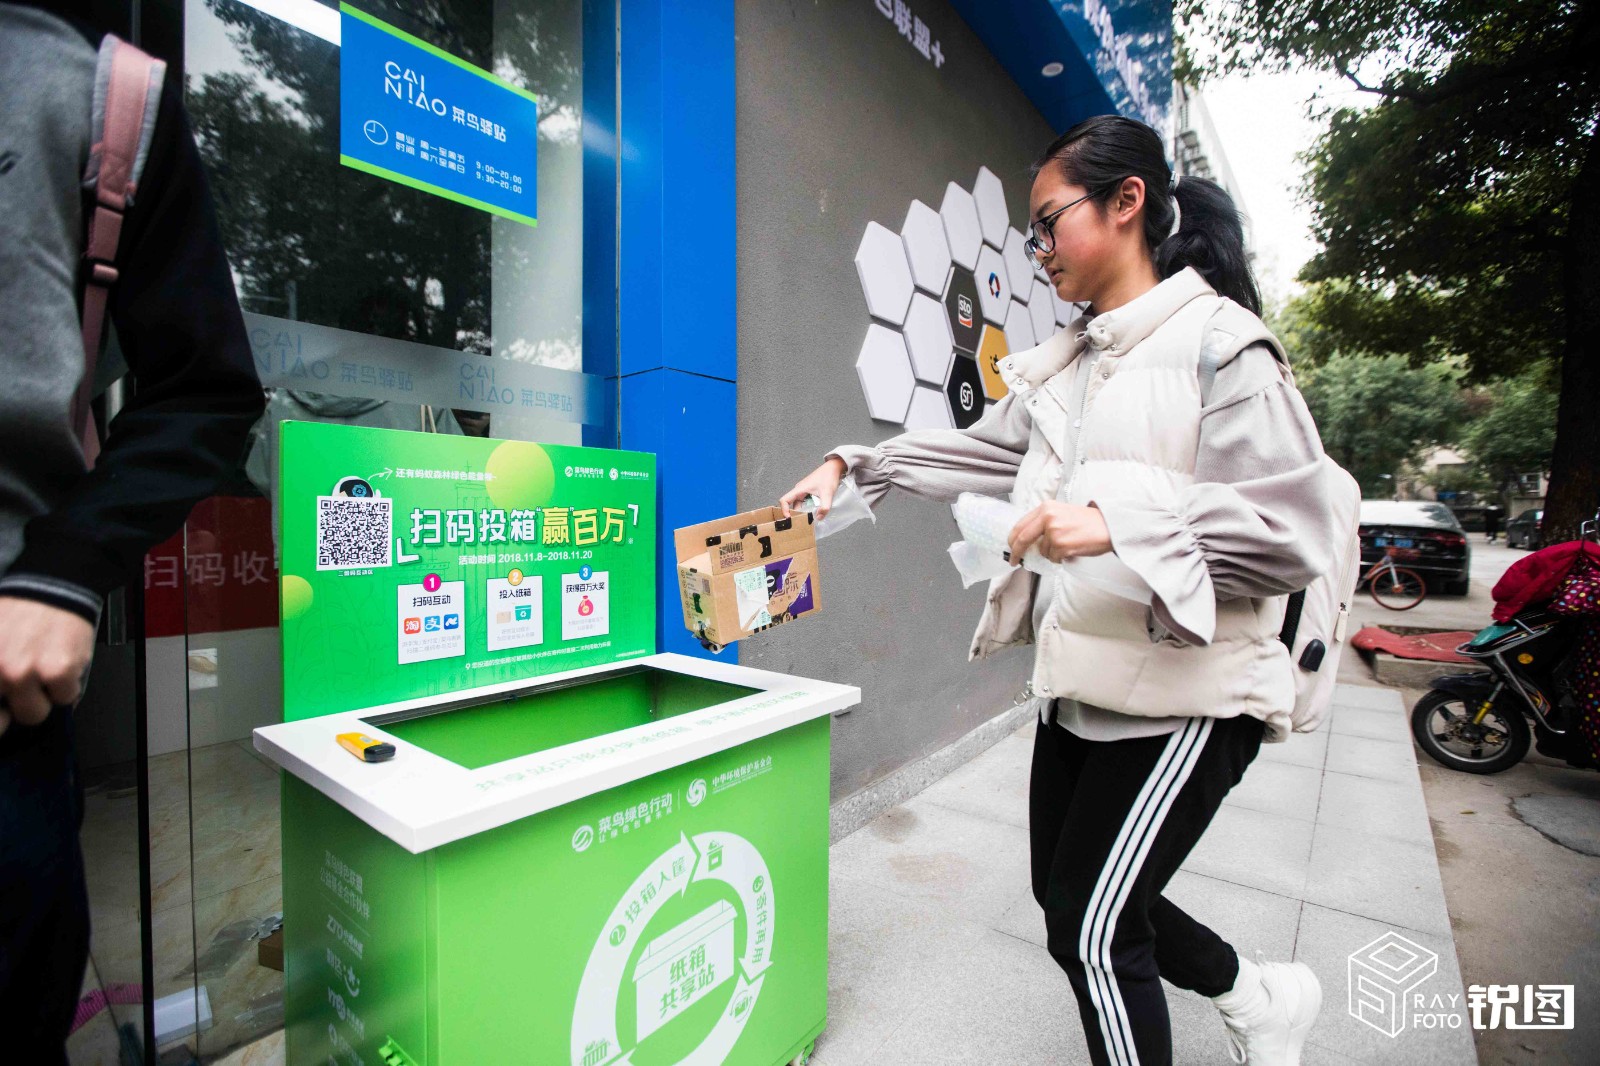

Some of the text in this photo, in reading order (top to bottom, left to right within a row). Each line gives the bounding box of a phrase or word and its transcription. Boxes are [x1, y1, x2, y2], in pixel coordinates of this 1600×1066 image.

[385, 61, 425, 92] CAI
[385, 77, 507, 143] NIAO 菜鸟驿站
[420, 140, 465, 164] 周一至周五
[476, 160, 522, 185] 9:00-20:00
[420, 150, 465, 174] 周六至周日
[476, 170, 522, 195] 9:30-20:00
[341, 361, 414, 392] 菜鸟驿站
[460, 362, 495, 387] CAI
[459, 380, 573, 412] NIAO 菜鸟驿站
[458, 550, 593, 566] 活动时间 2018.11.8-2018.11.20
[412, 594, 451, 608] 扫码互动
[499, 588, 532, 600] 投入纸箱
[565, 582, 605, 594] 获得百万大奖
[599, 792, 673, 834] 菜鸟绿色行动
[669, 944, 706, 986] 纸箱
[659, 963, 715, 1019] 共享站
